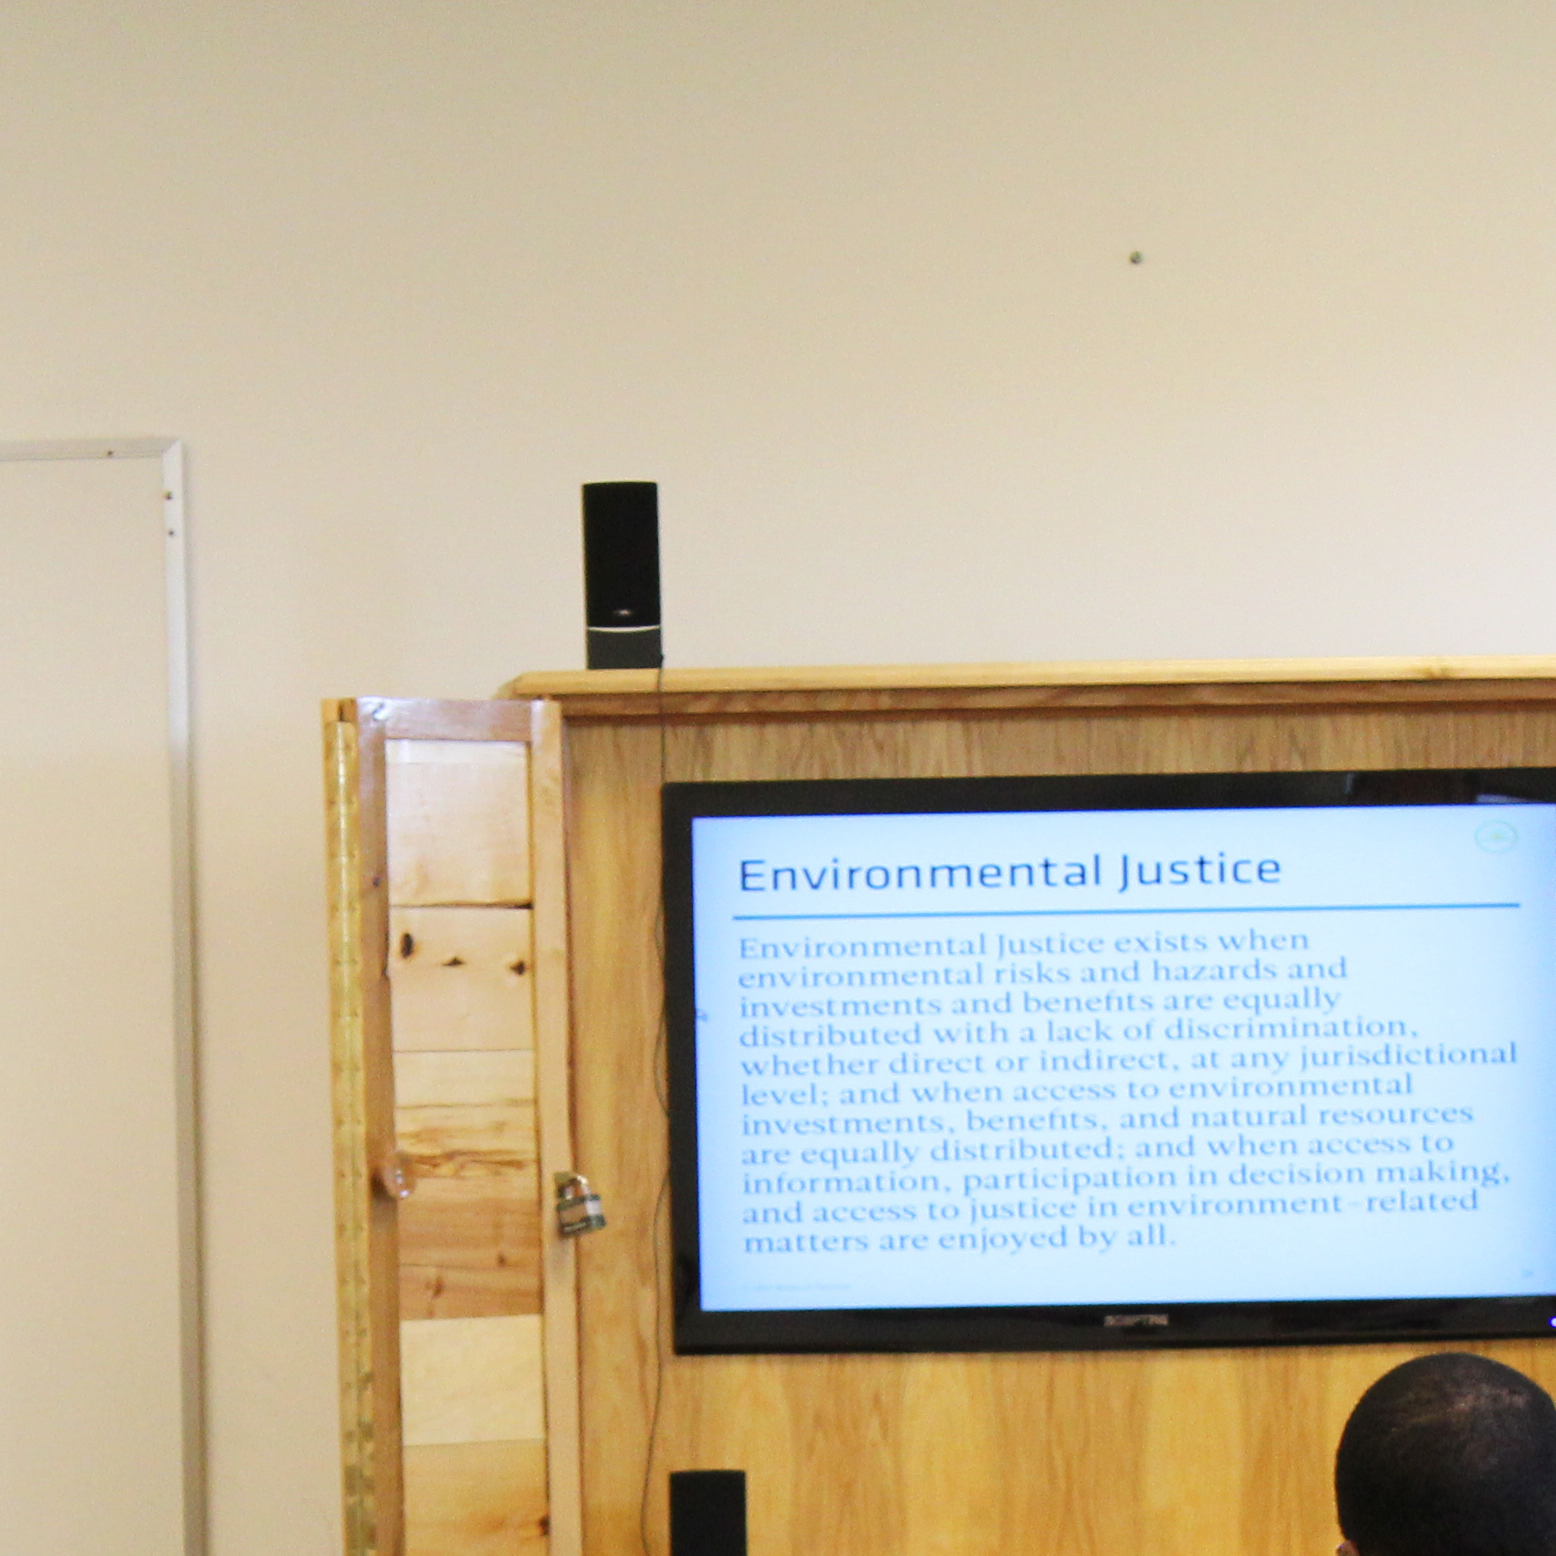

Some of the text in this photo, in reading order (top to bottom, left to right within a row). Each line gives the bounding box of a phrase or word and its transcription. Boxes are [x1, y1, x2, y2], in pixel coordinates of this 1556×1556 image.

[738, 850, 1282, 893] Environmental Justice
[738, 927, 1311, 962] Environmental Justice exists when
[736, 955, 1349, 989] environmental risks and hazards and
[737, 984, 1343, 1018] investments and benefits are equally
[737, 1012, 1419, 1048] distributed with a lack of discrimination,
[739, 1041, 1519, 1078] whether direct or indirect, at any jurisdictional
[740, 1071, 1414, 1110] level; and when access to environmental
[740, 1102, 1475, 1139] investments, benefits, and natural resources
[740, 1128, 1456, 1171] are equally distributed; and when access to
[741, 1157, 1511, 1199] information, participation in decision making,
[741, 1199, 804, 1224] and
[811, 1203, 918, 1223] access
[926, 1198, 961, 1221] to
[968, 1193, 1082, 1226] justice
[1087, 1193, 1119, 1218] in
[741, 1222, 1177, 1257] matters are enjoyed by all.
